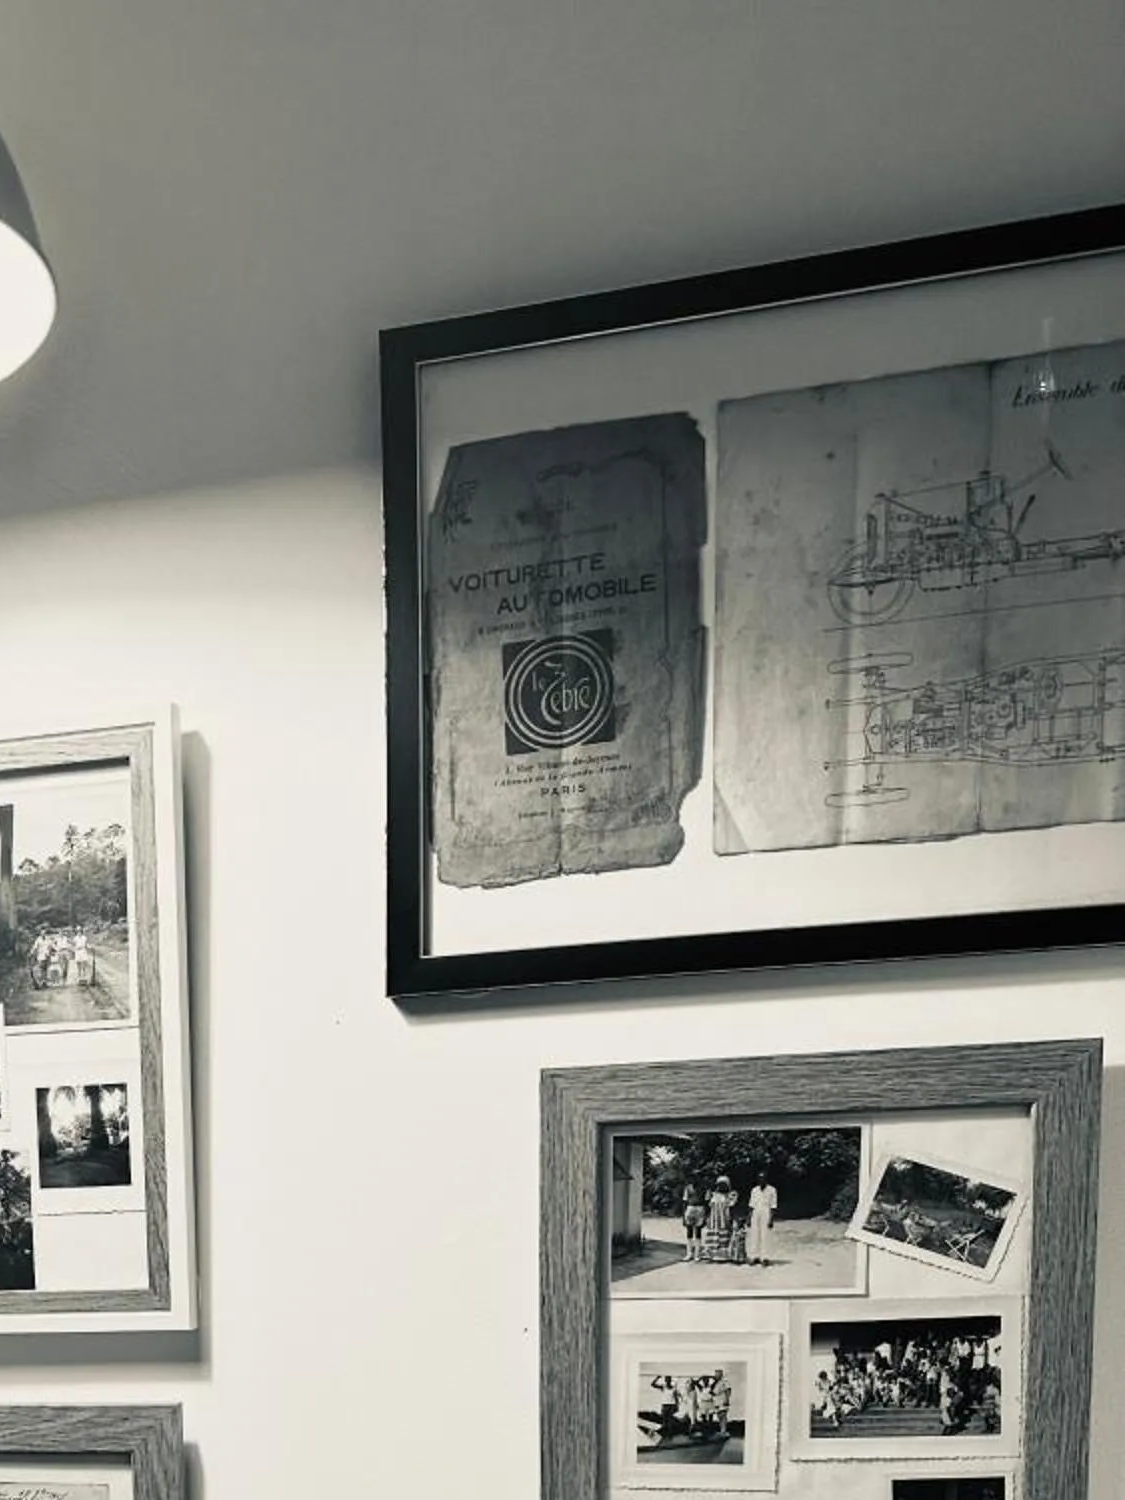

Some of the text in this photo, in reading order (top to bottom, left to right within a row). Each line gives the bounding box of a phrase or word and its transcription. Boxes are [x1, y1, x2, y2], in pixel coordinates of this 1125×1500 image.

[448, 552, 606, 593] VOITURETTE
[496, 573, 658, 615] AUTOMOBILE
[540, 784, 586, 796] PARIS
